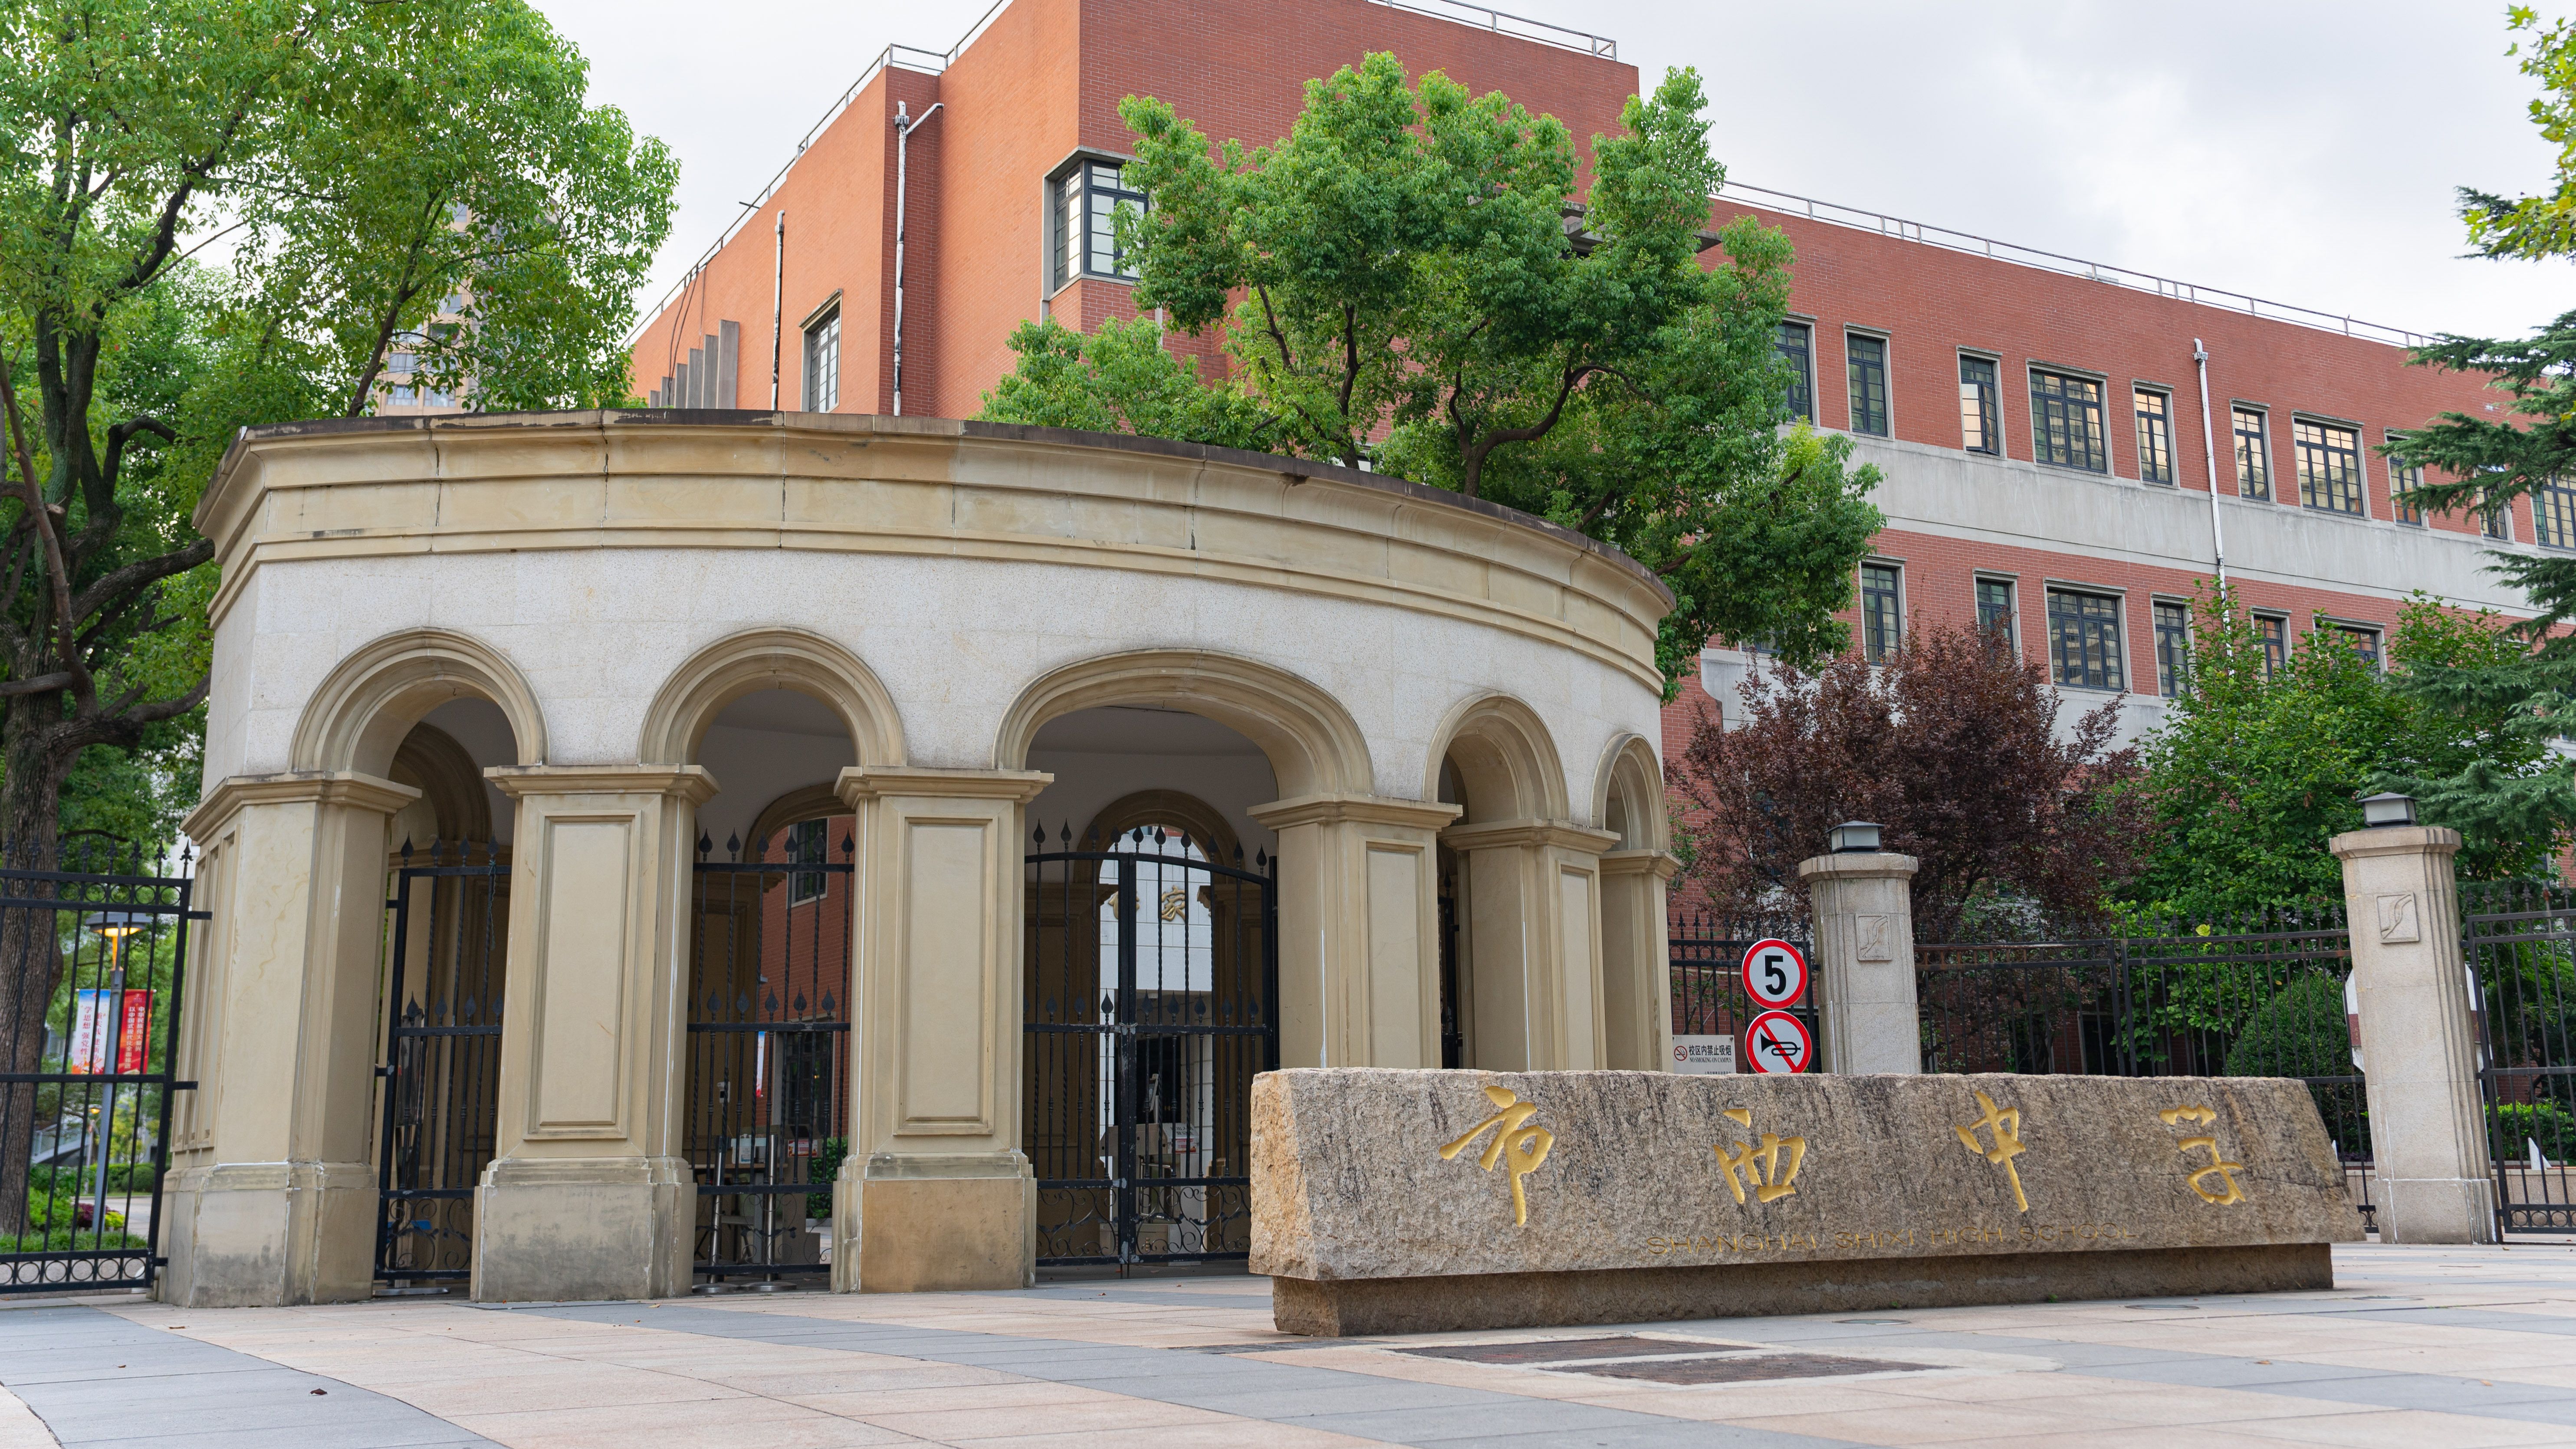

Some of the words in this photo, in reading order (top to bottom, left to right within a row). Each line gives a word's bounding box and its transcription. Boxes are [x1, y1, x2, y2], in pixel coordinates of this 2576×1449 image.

[1764, 955, 1786, 995] 5
[124, 1006, 136, 1068] 以中国式现代化全面推进
[135, 1006, 145, 1051] 中华民族伟大复兴
[1689, 1045, 1732, 1055] 校区内禁止吸烟
[1439, 1085, 2246, 1227] 市西中学
[1647, 1233, 1817, 1254] SHANGHAI
[1835, 1229, 1915, 1249] SHIXI
[1931, 1226, 2003, 1245] HIGH
[2020, 1222, 2139, 1242] SCHOOL
